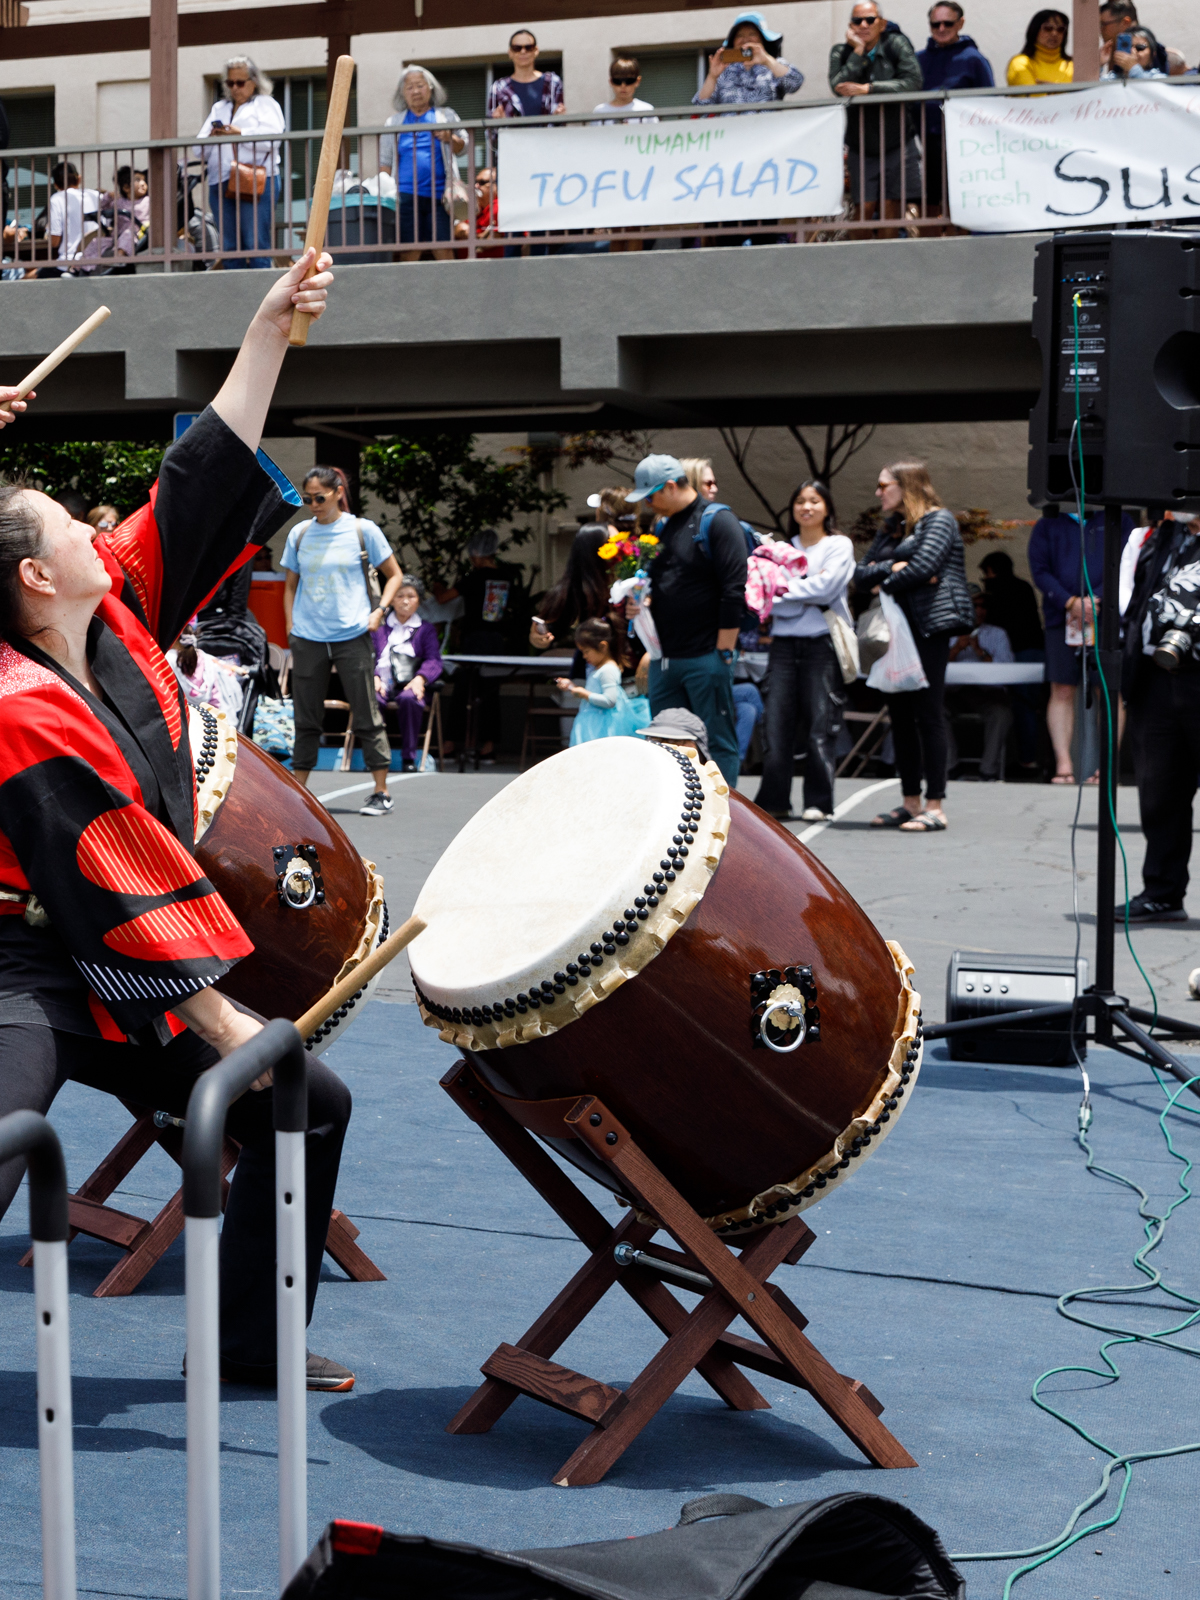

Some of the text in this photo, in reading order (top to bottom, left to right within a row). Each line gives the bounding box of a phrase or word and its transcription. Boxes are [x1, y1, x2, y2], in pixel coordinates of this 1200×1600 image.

[959, 106, 1059, 128] Buddhist
[1070, 99, 1161, 123] Womens
[624, 129, 725, 155] "UMAMI"
[959, 130, 1073, 157] Delicious
[529, 157, 820, 208] TOFU SALAD
[959, 156, 1006, 183] and
[961, 181, 1031, 209] Fresh
